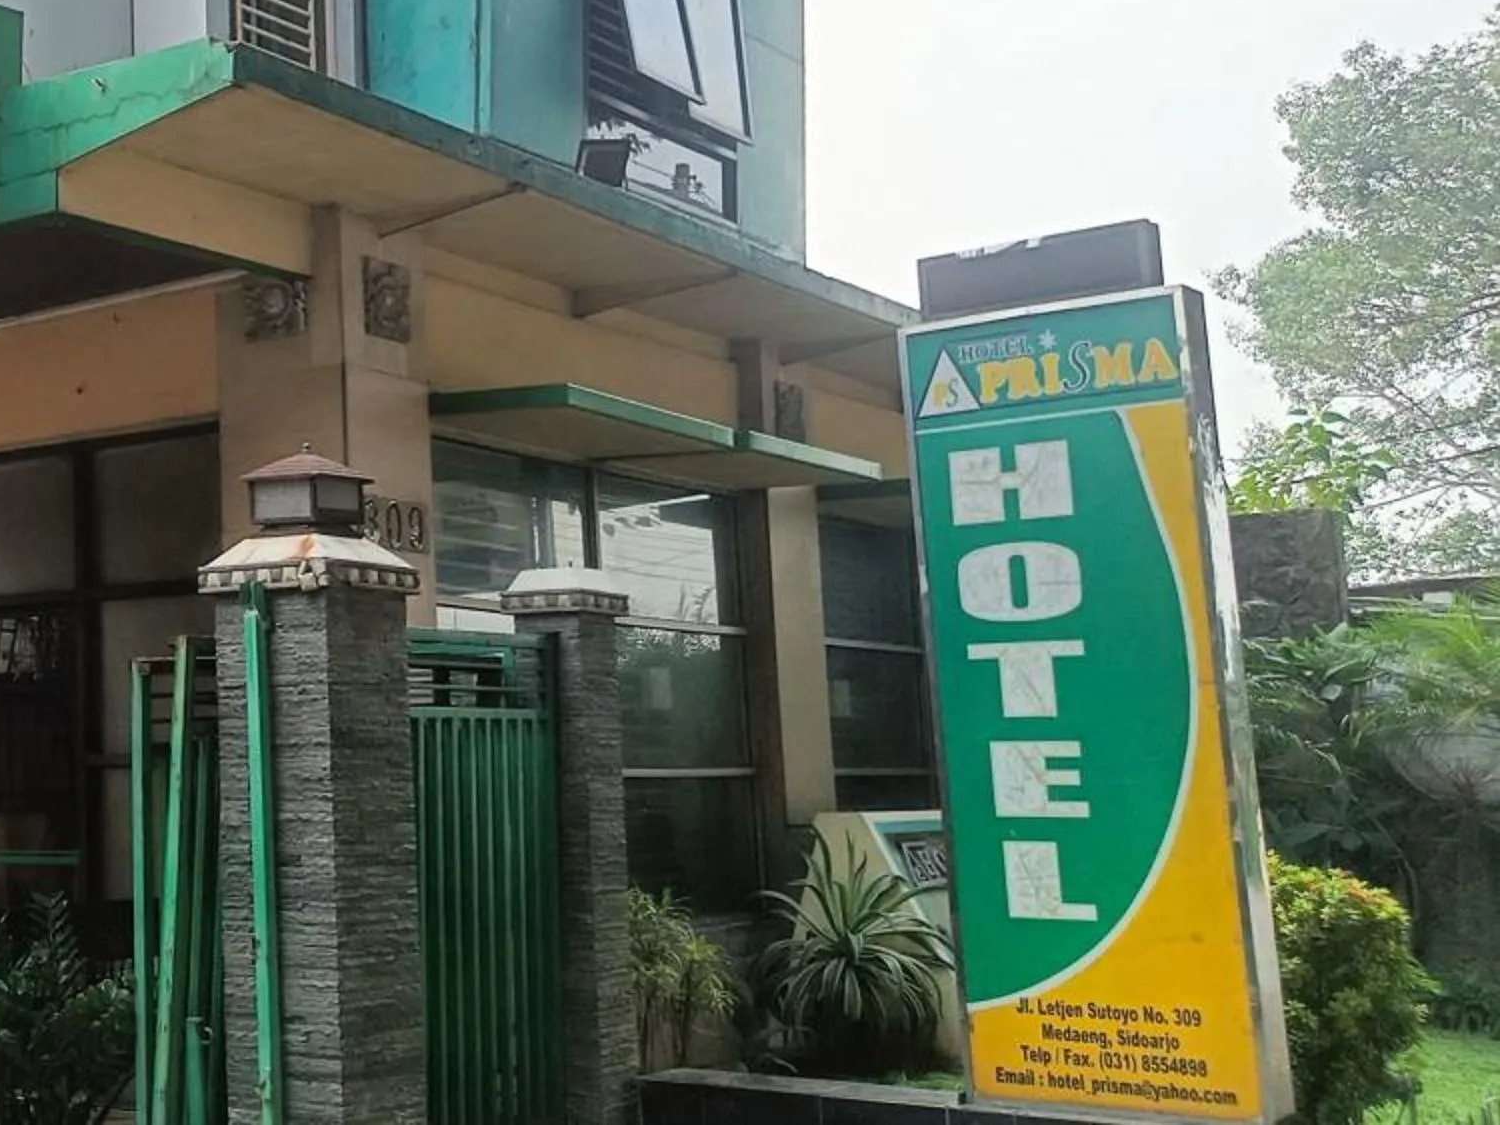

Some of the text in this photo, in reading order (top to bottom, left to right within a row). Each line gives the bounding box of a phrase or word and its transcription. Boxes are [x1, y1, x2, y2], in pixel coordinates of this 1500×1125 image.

[958, 336, 1034, 363] HOTEL
[363, 499, 423, 551] 309
[947, 439, 1098, 922] HOTEL
[1016, 997, 1202, 1027] Jl. Letjen Sutoyo No. 309
[1117, 1029, 1180, 1053] Sidoarjo
[1020, 1044, 1051, 1067] Telp
[1063, 1048, 1095, 1068] Fax.
[1100, 1051, 1137, 1073] (031)
